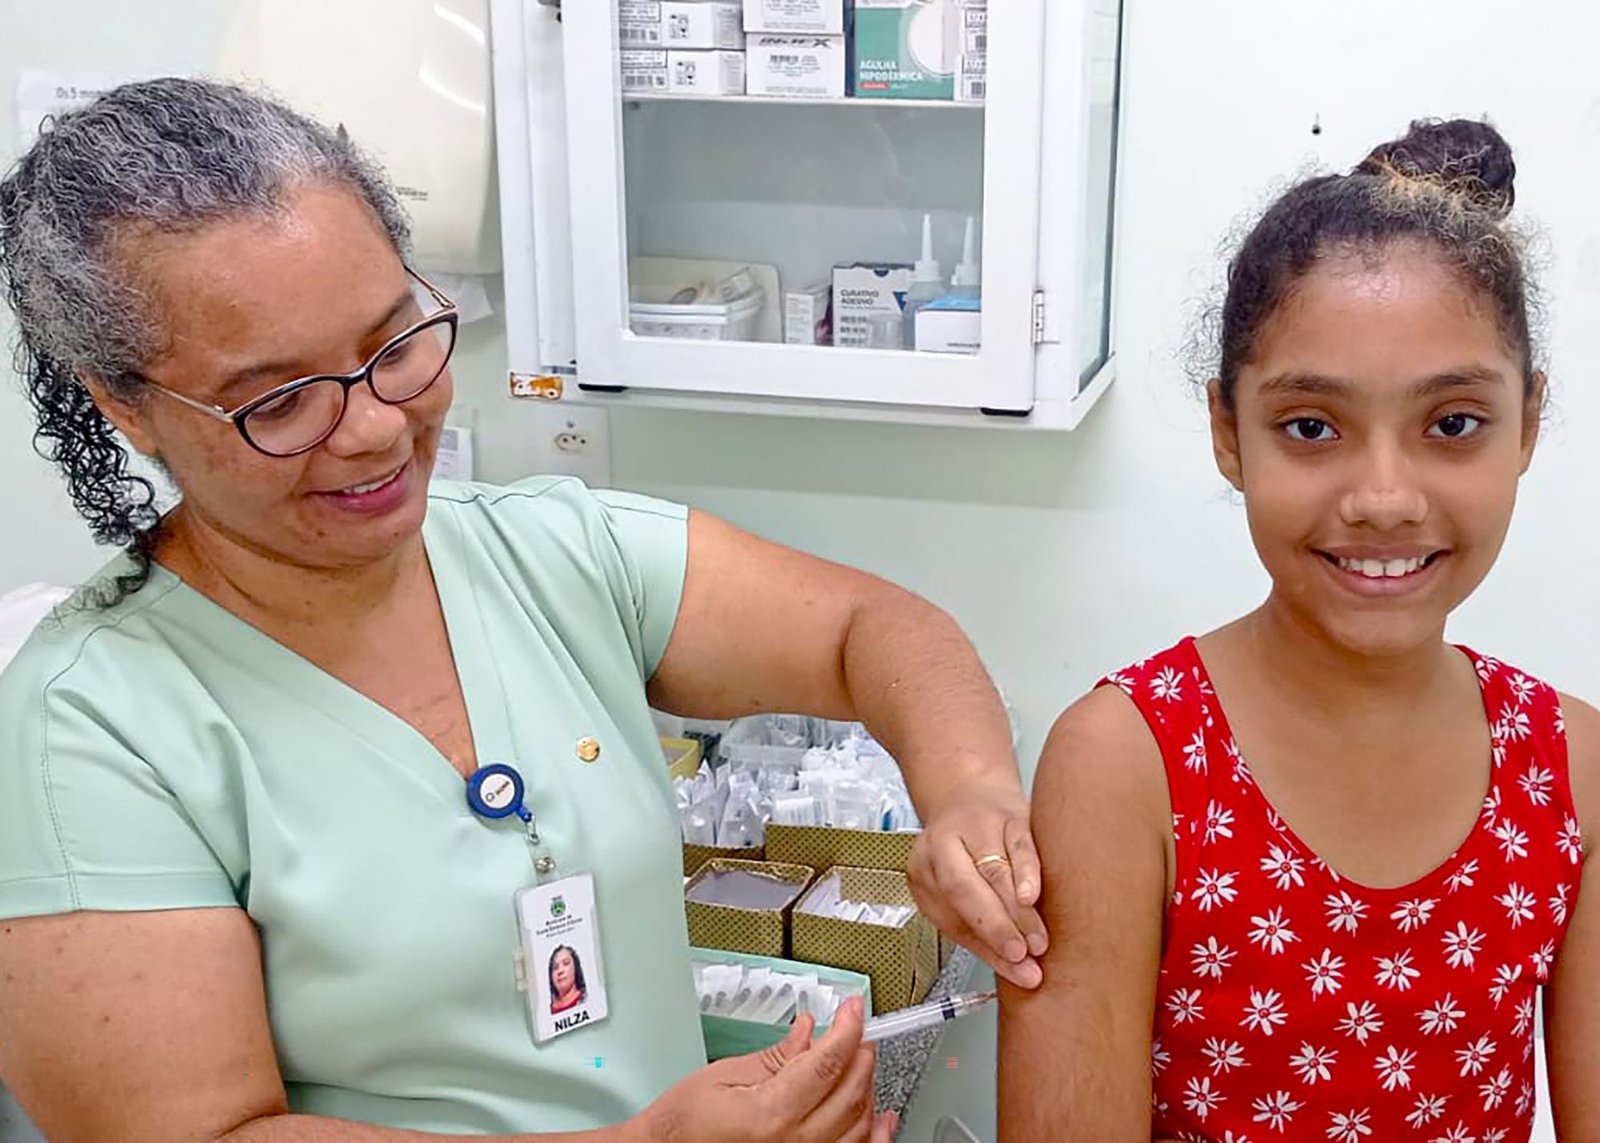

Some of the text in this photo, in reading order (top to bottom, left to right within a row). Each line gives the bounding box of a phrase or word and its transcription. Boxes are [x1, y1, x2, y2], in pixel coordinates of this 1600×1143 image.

[860, 60, 897, 70] AGULHA
[840, 289, 879, 298] CURATIVO
[555, 1010, 590, 1032] NILZA
